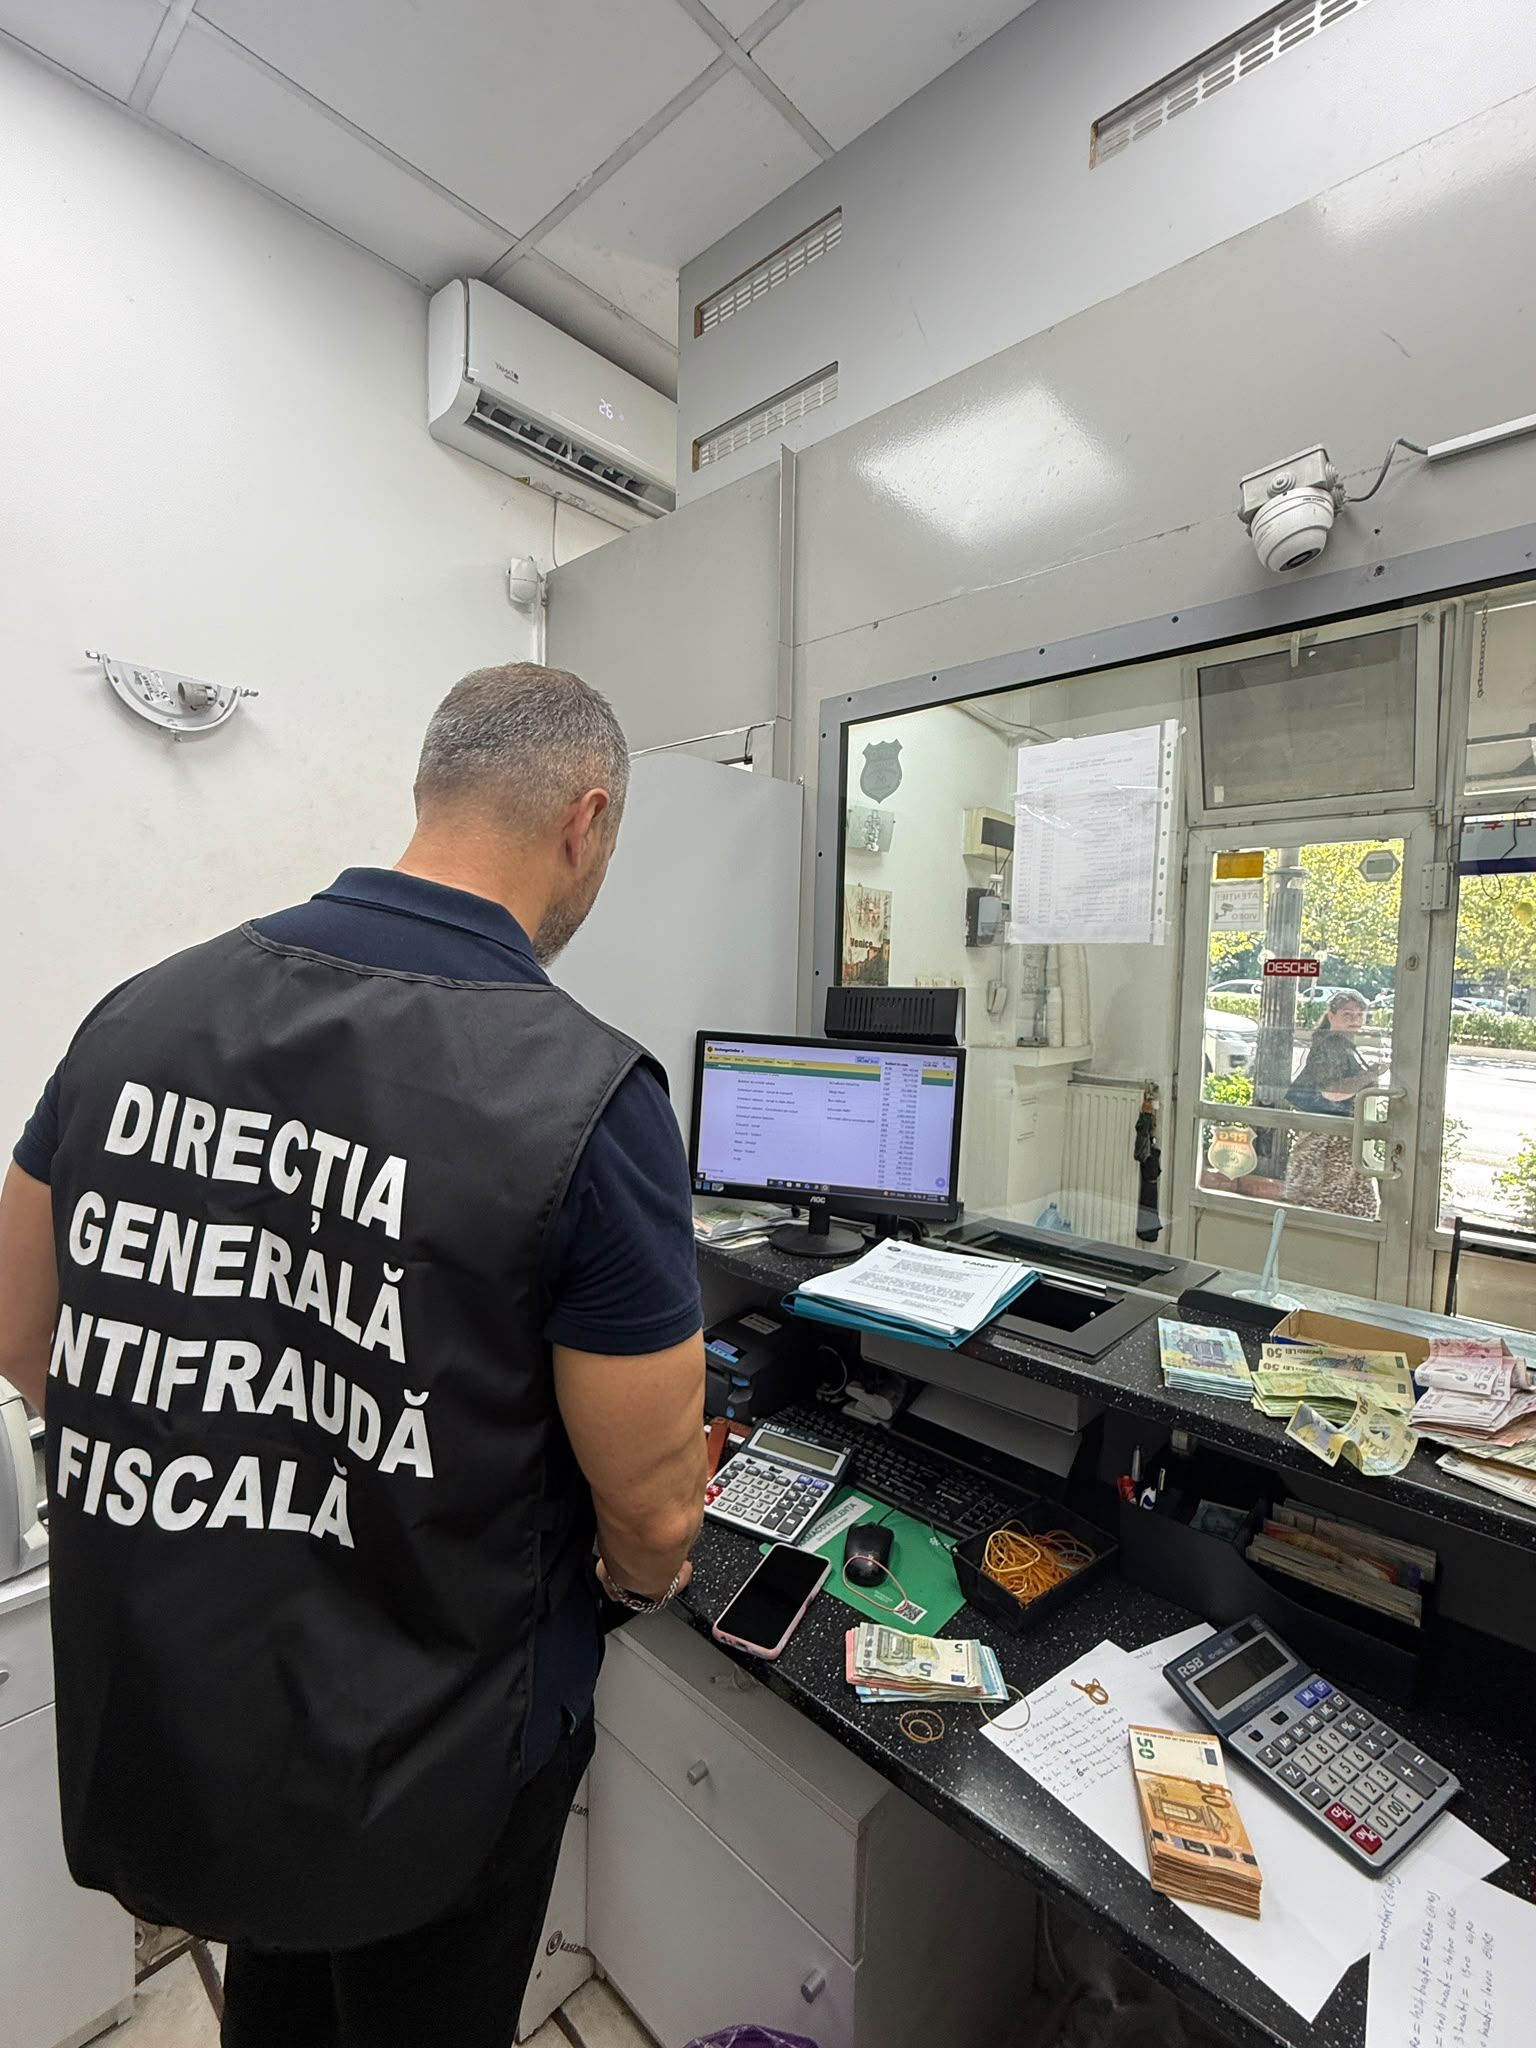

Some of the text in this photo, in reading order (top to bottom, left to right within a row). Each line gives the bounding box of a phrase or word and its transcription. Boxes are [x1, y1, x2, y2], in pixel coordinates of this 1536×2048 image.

[599, 399, 613, 420] 26
[850, 937, 873, 949] Venice
[1266, 961, 1318, 975] DESCHIS
[104, 1081, 407, 1240] DIRECȚIA
[69, 1191, 406, 1364] GENERALĂ
[1266, 1347, 1282, 1358] 50
[1263, 1362, 1280, 1372] 50
[48, 1303, 434, 1479] NTIFRAUDĂ
[1474, 1382, 1487, 1391] 5
[1494, 1389, 1505, 1398] 5
[57, 1426, 355, 1549] FISCALĂ
[954, 1643, 963, 1653] 5
[919, 1662, 933, 1677] 5
[1177, 1657, 1204, 1678] RSB
[1137, 1737, 1155, 1760] 50
[1300, 1754, 1312, 1766] 7
[1316, 1743, 1328, 1754] 8
[1329, 1732, 1340, 1743] 9
[1327, 1774, 1338, 1785] 4
[1339, 1762, 1351, 1774] 5
[1352, 1750, 1364, 1762] 6
[1350, 1794, 1362, 1806] 1
[1364, 1781, 1377, 1794] 2
[1376, 1770, 1389, 1782] 3
[1375, 1815, 1388, 1828] 0
[1387, 1801, 1404, 1817] 00
